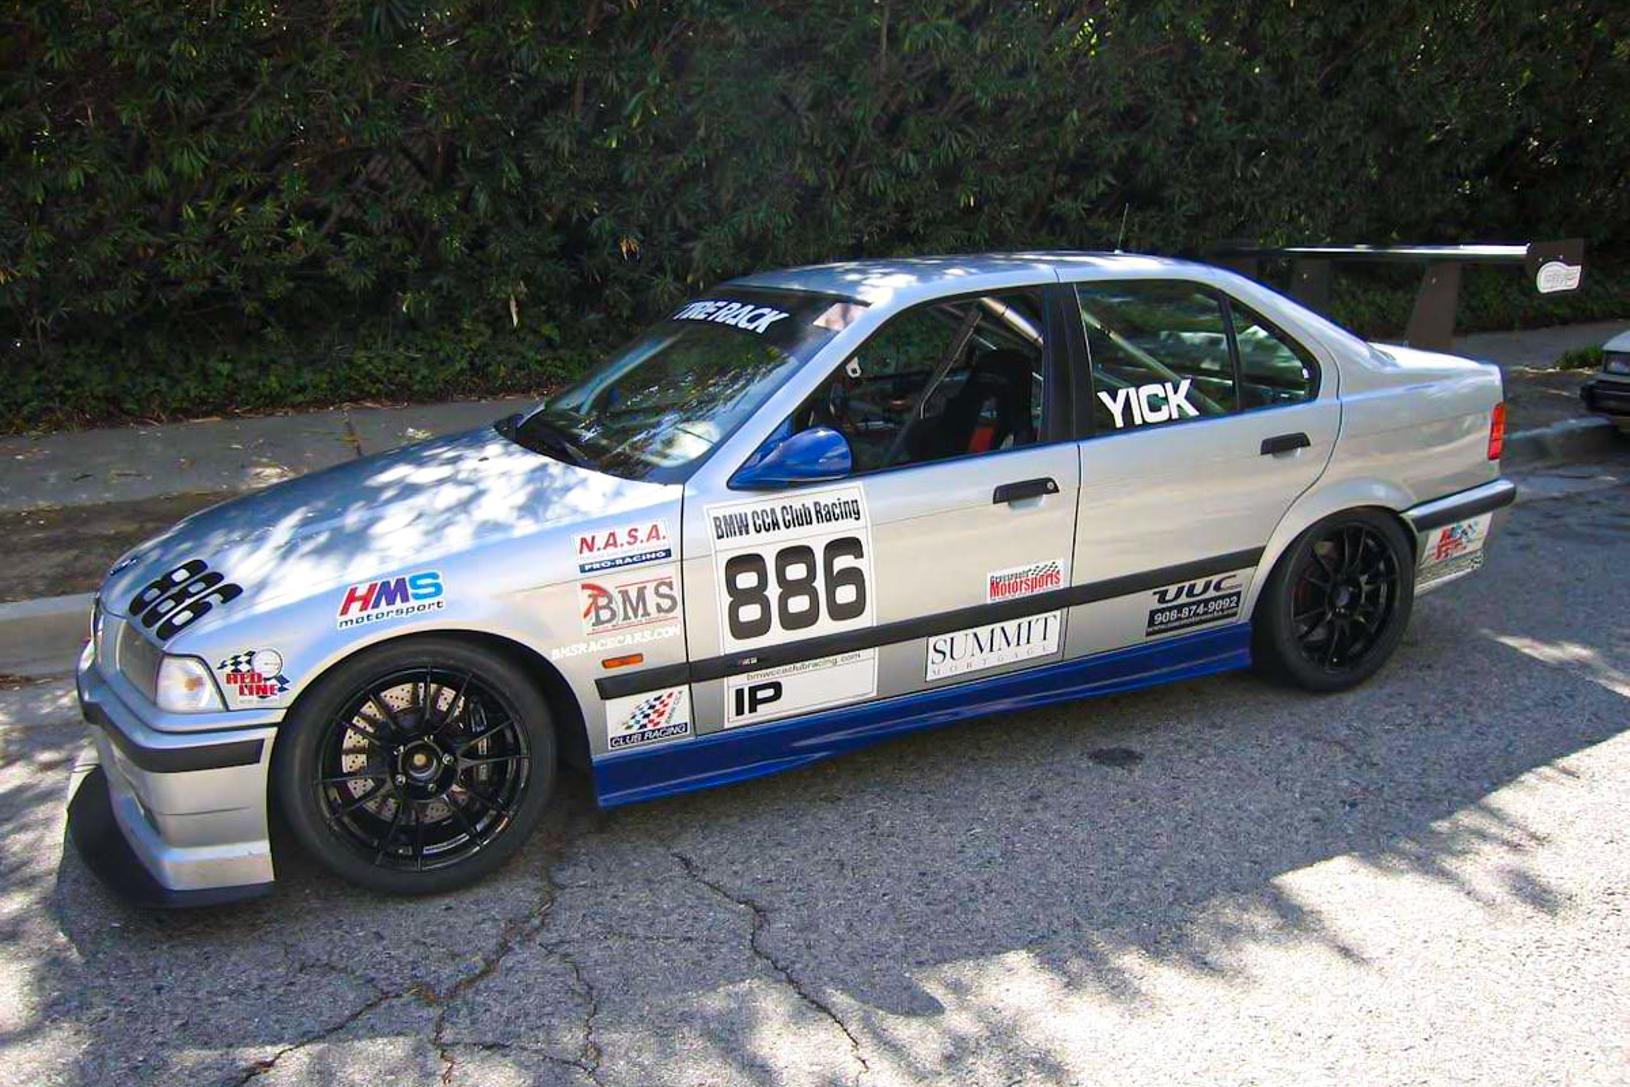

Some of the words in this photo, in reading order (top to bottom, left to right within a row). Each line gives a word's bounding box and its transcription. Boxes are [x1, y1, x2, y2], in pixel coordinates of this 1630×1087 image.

[709, 302, 790, 334] RACK
[1097, 379, 1200, 428] YICK
[713, 511, 750, 540] BMW
[752, 506, 781, 534] CCA
[781, 503, 813, 529] Club
[814, 498, 861, 523] Racing
[579, 524, 667, 554] N.A.S.A.
[129, 559, 244, 641] 886
[339, 571, 443, 616] HMS
[725, 536, 867, 640] 886
[989, 570, 1061, 598] Motorsports
[340, 600, 444, 629] motorsport
[582, 580, 678, 627] BMS
[1154, 596, 1238, 625] 908-874-9092
[931, 614, 1057, 665] SUMMIT
[735, 681, 783, 716] IP
[611, 733, 642, 747] CLUB
[644, 724, 687, 740] RACING
